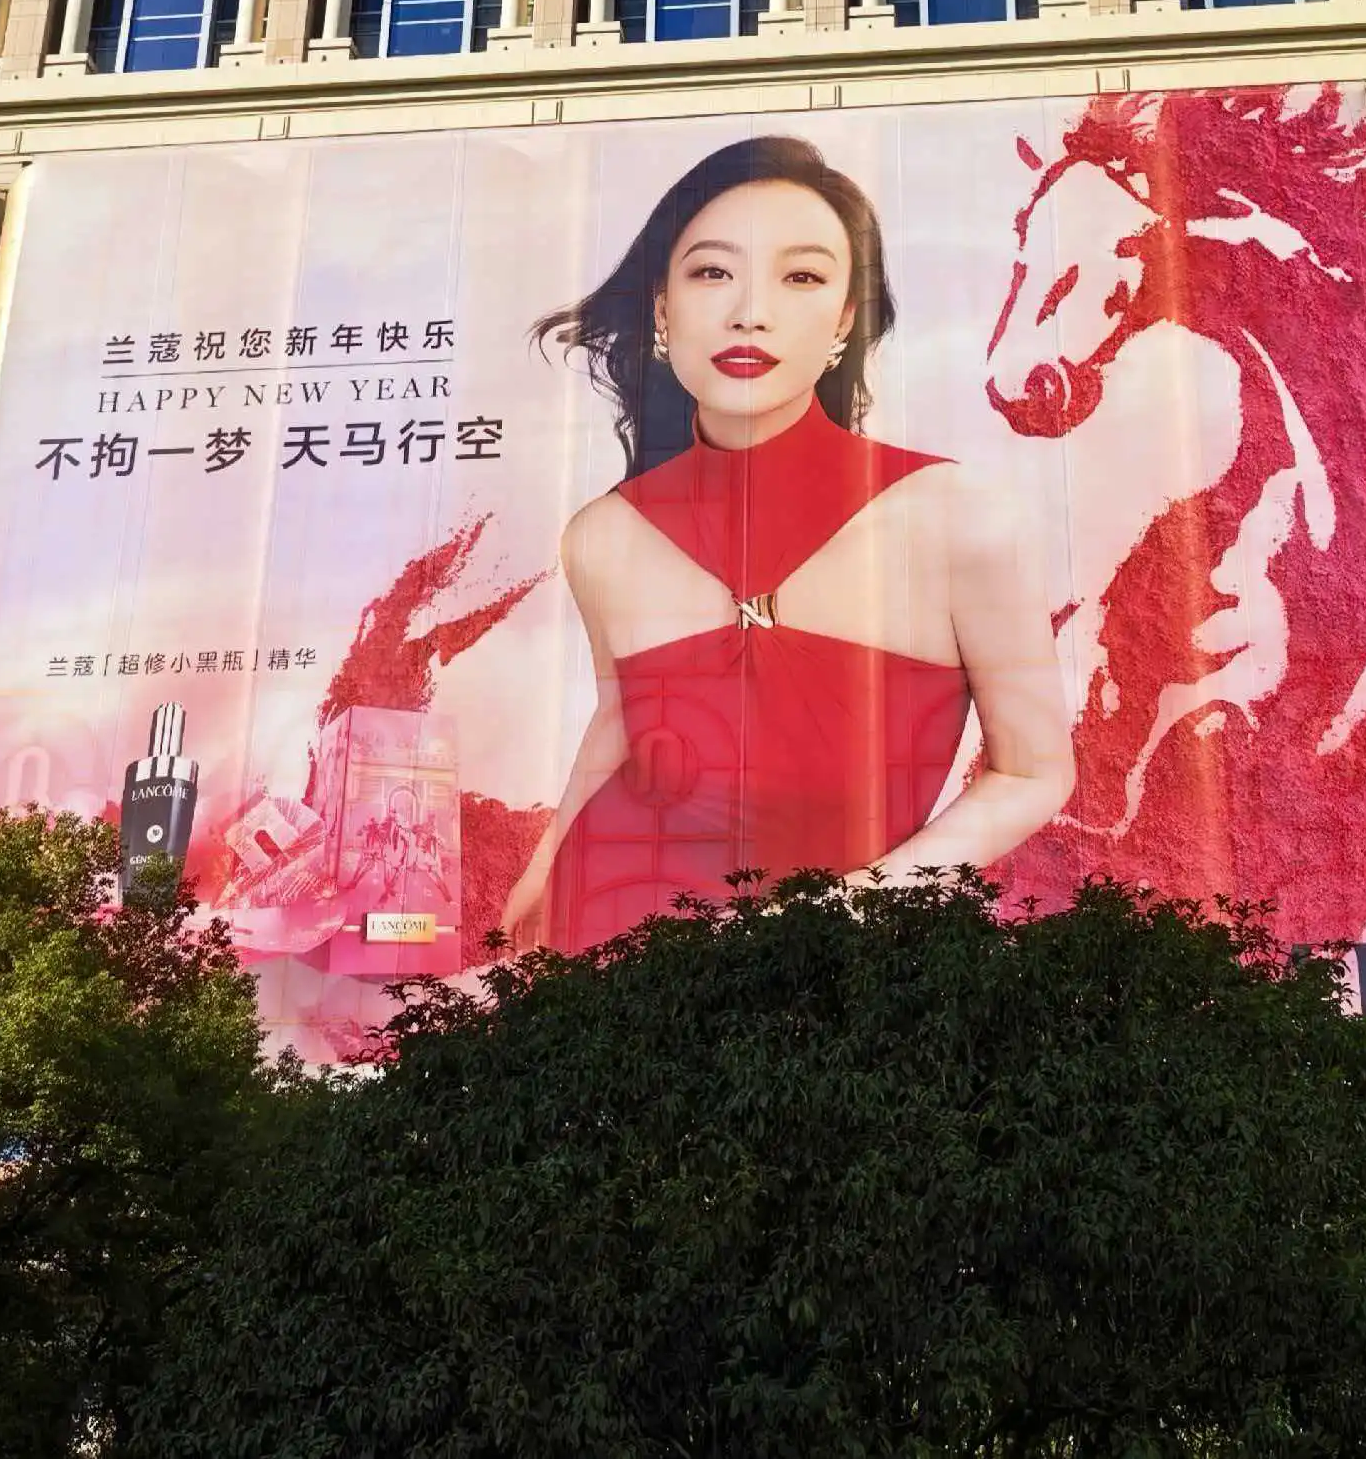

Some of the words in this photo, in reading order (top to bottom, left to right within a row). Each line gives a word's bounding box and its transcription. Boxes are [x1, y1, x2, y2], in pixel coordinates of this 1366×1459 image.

[102, 319, 455, 365] 兰蔻祝您新年快乐
[98, 385, 226, 414] HAPPY
[243, 380, 332, 407] NEW
[349, 375, 453, 401] YEAR
[35, 426, 252, 481] 不拘一梦
[281, 415, 504, 470] 天马行空
